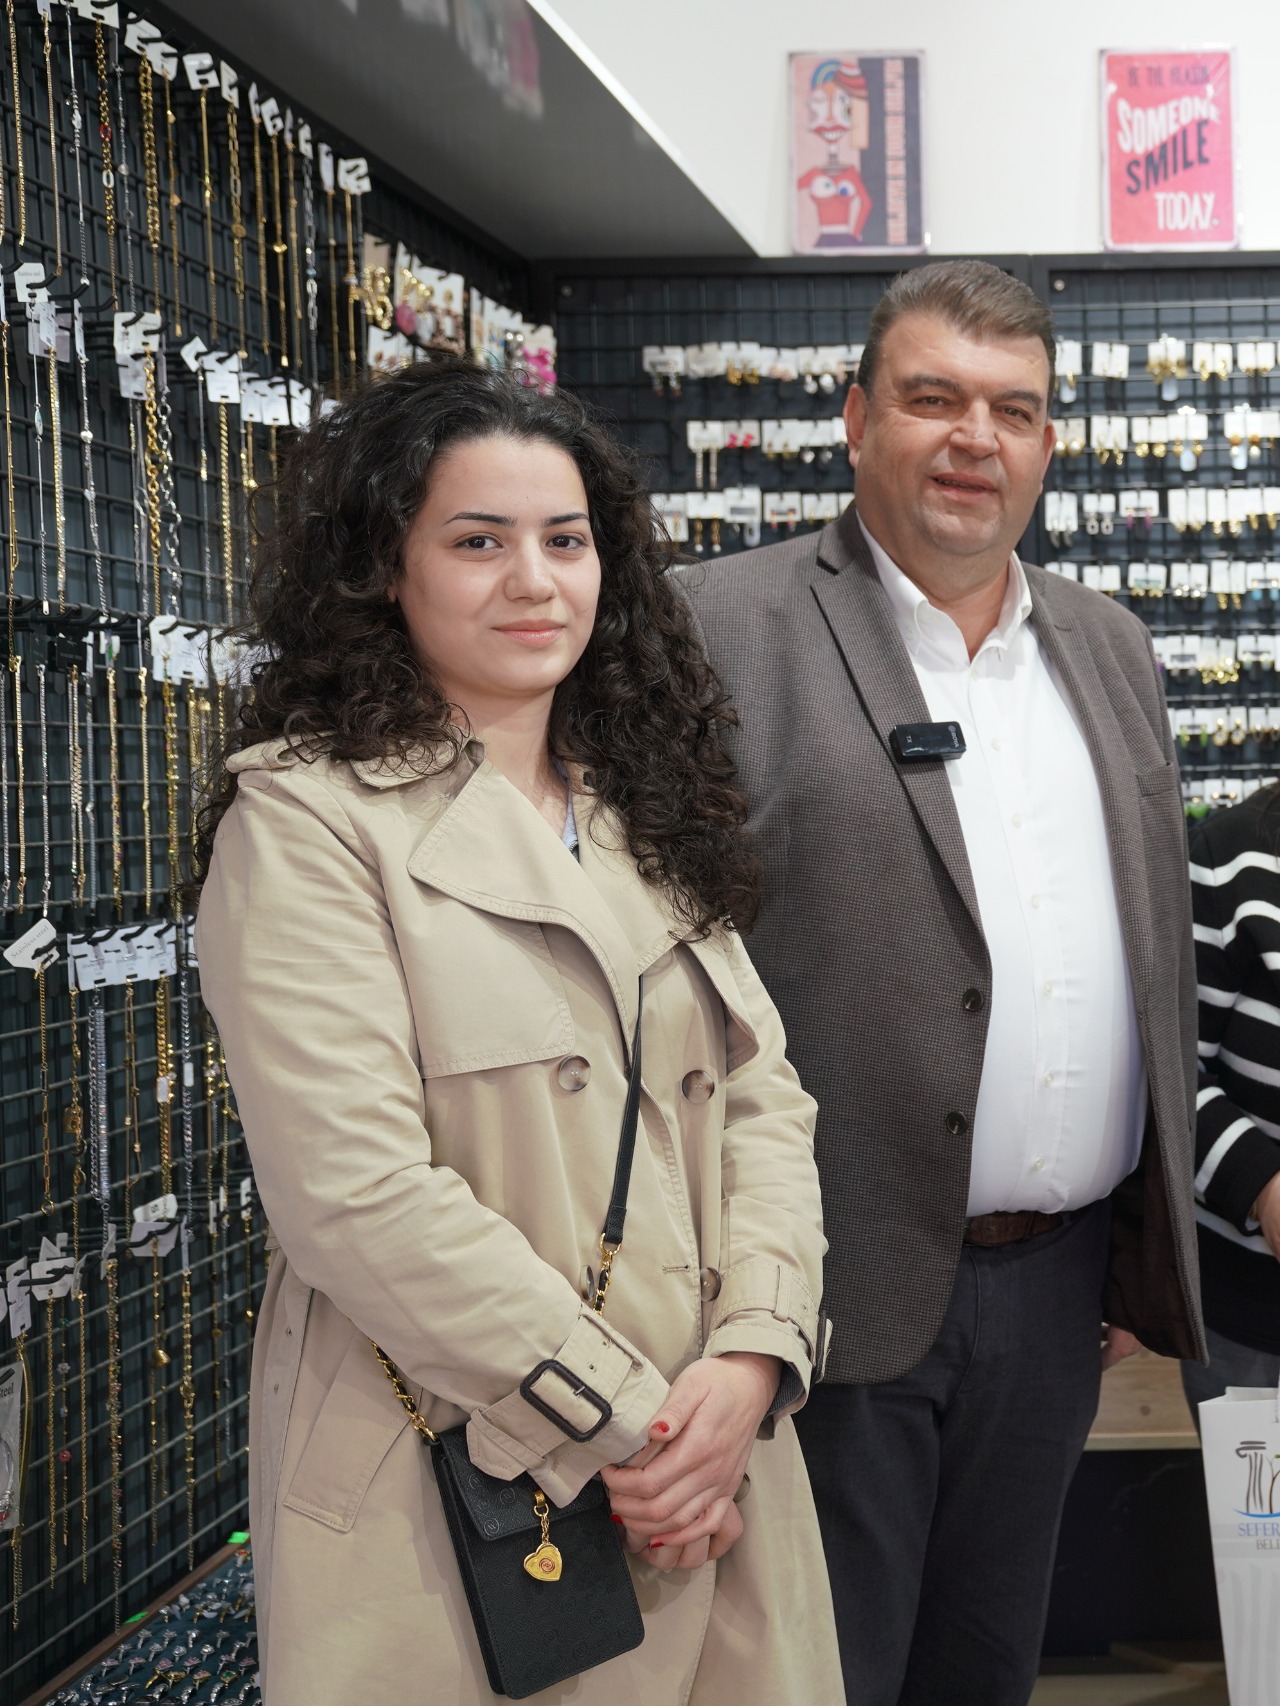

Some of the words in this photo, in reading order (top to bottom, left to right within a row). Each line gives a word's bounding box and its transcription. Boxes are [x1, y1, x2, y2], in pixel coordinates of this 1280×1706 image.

[1126, 119, 1209, 195] SMILE
[11, 937, 37, 960] Stainless
[36, 924, 49, 938] steel
